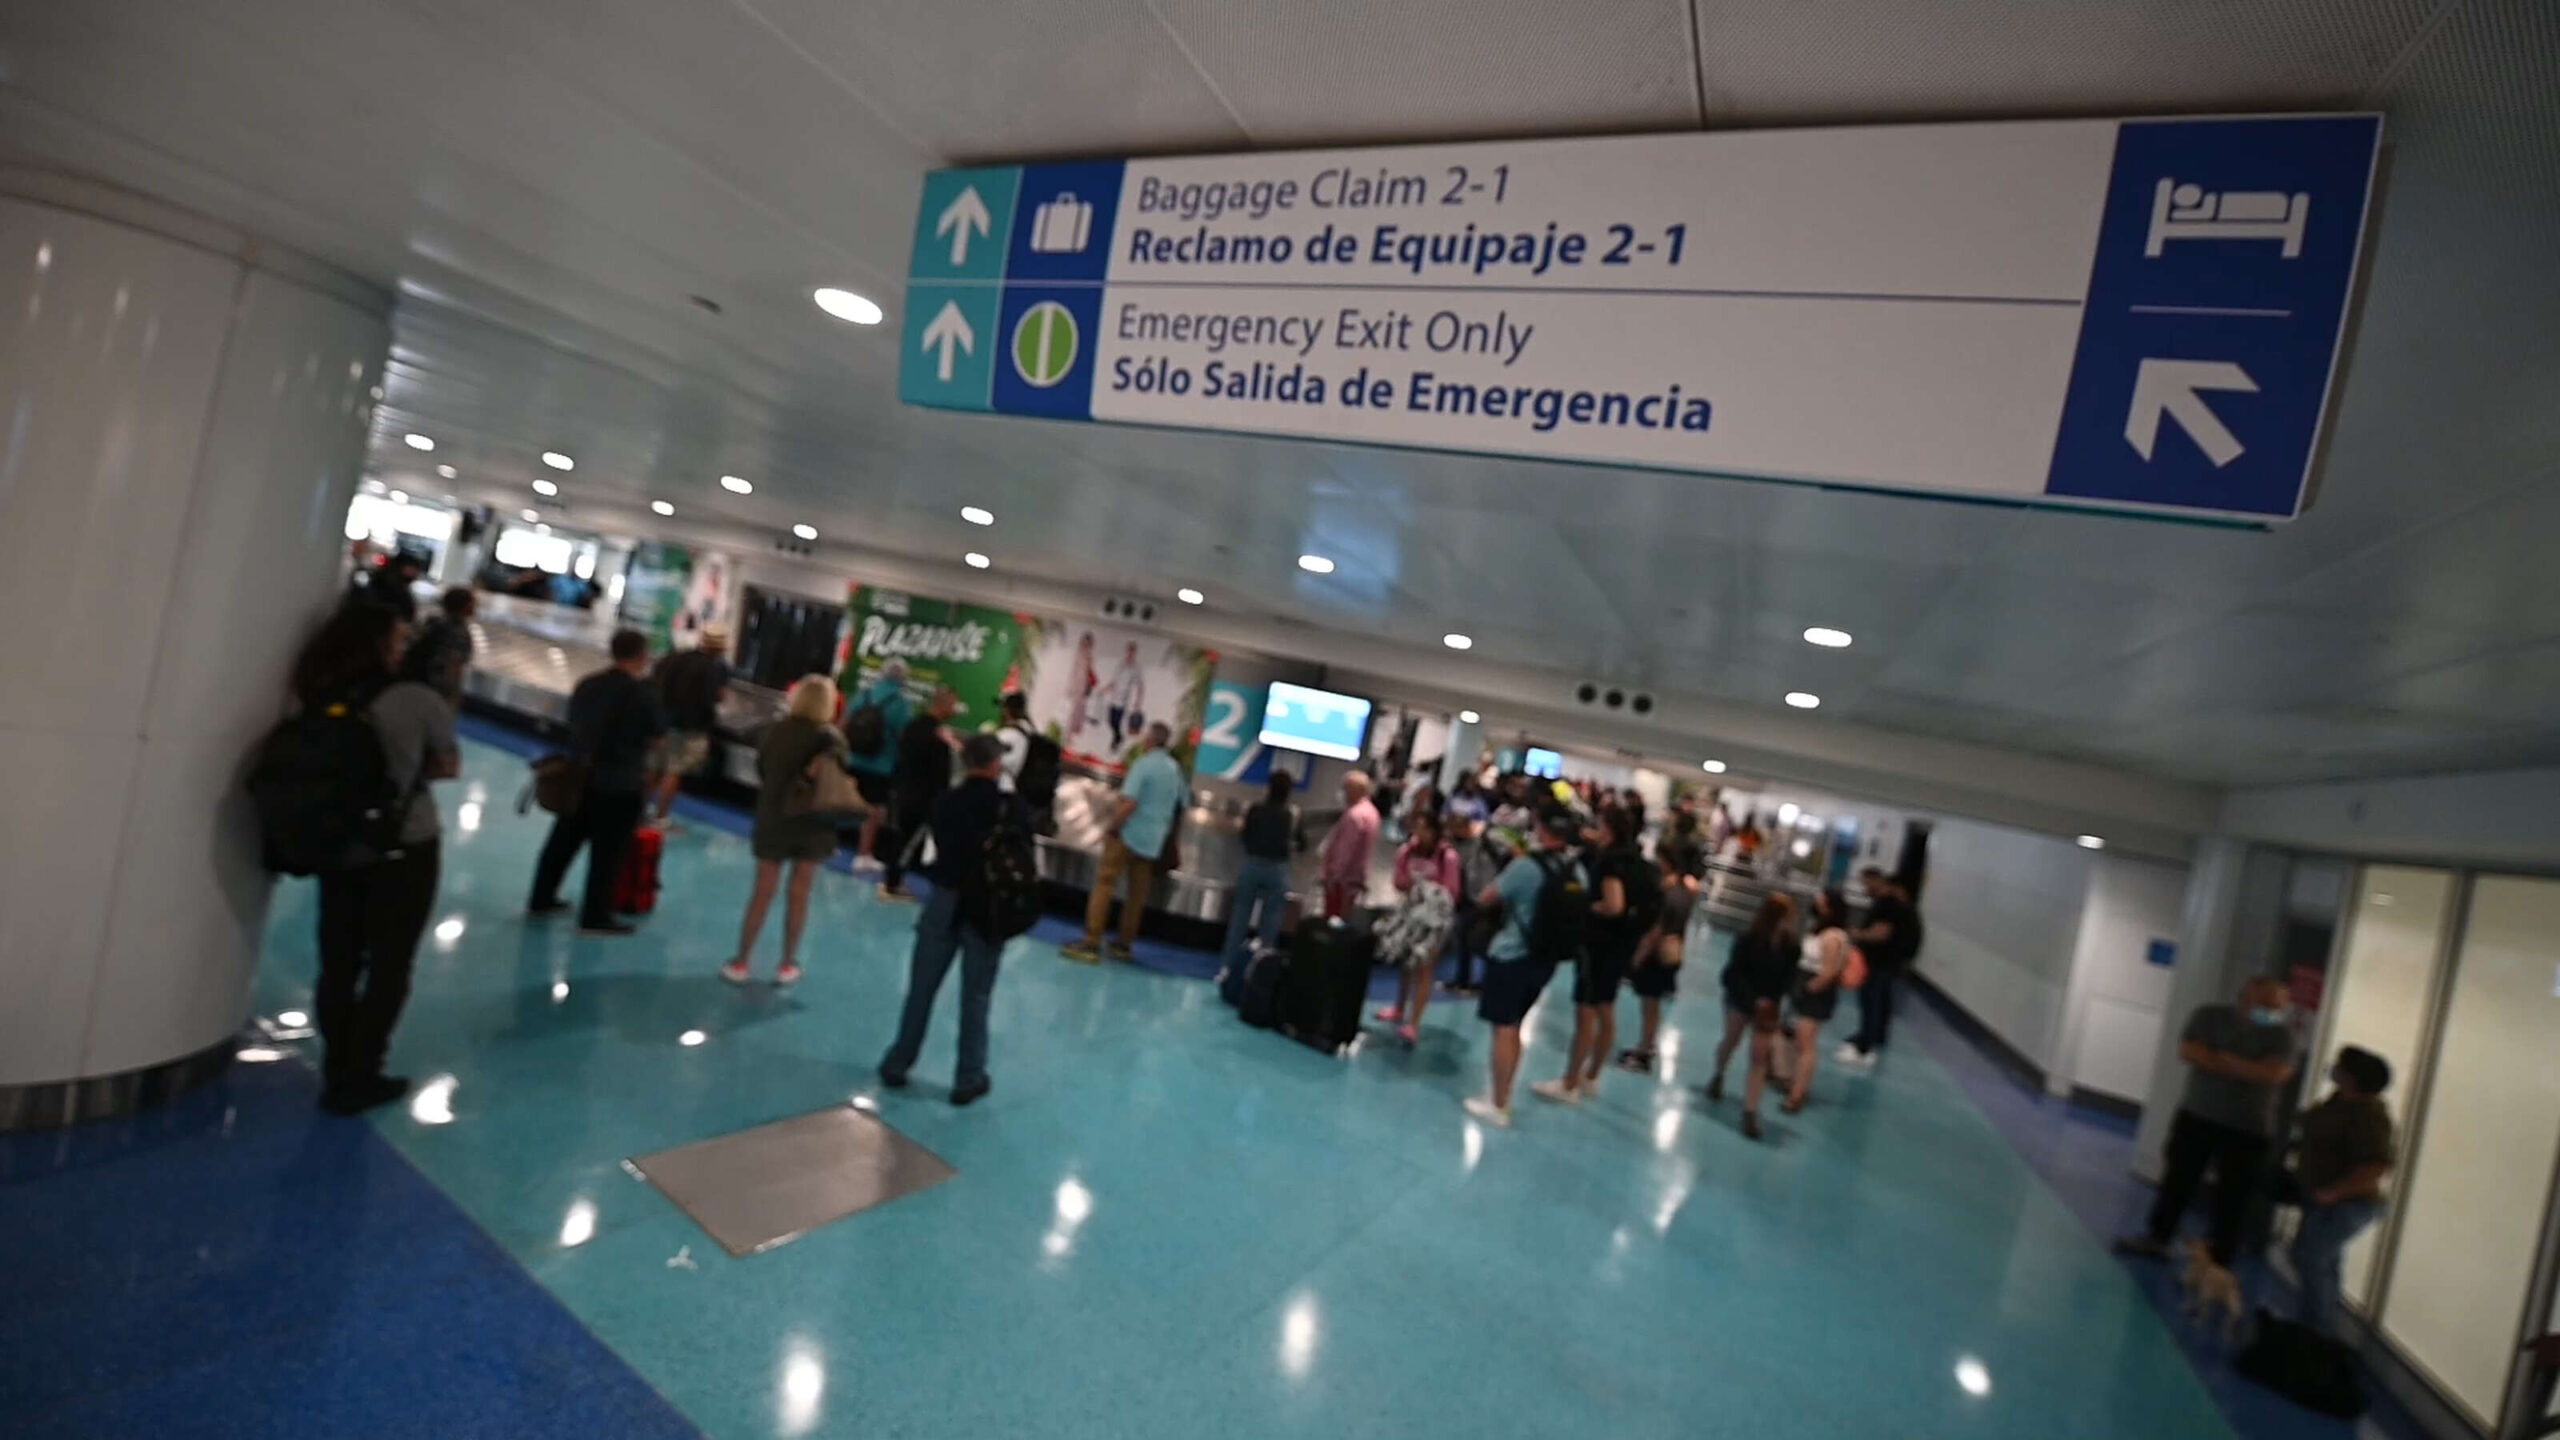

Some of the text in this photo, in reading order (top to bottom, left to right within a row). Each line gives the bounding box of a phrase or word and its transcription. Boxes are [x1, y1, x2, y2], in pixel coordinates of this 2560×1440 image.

[1138, 164, 1510, 220] Baggage Claim 2-1
[1129, 222, 1687, 276] Reclamo de Equipaje 2-1
[1117, 303, 1534, 367] Emergency Exit Only
[1112, 356, 1713, 432] Sólo Salida de Emergencia
[1202, 690, 1247, 747] 2
